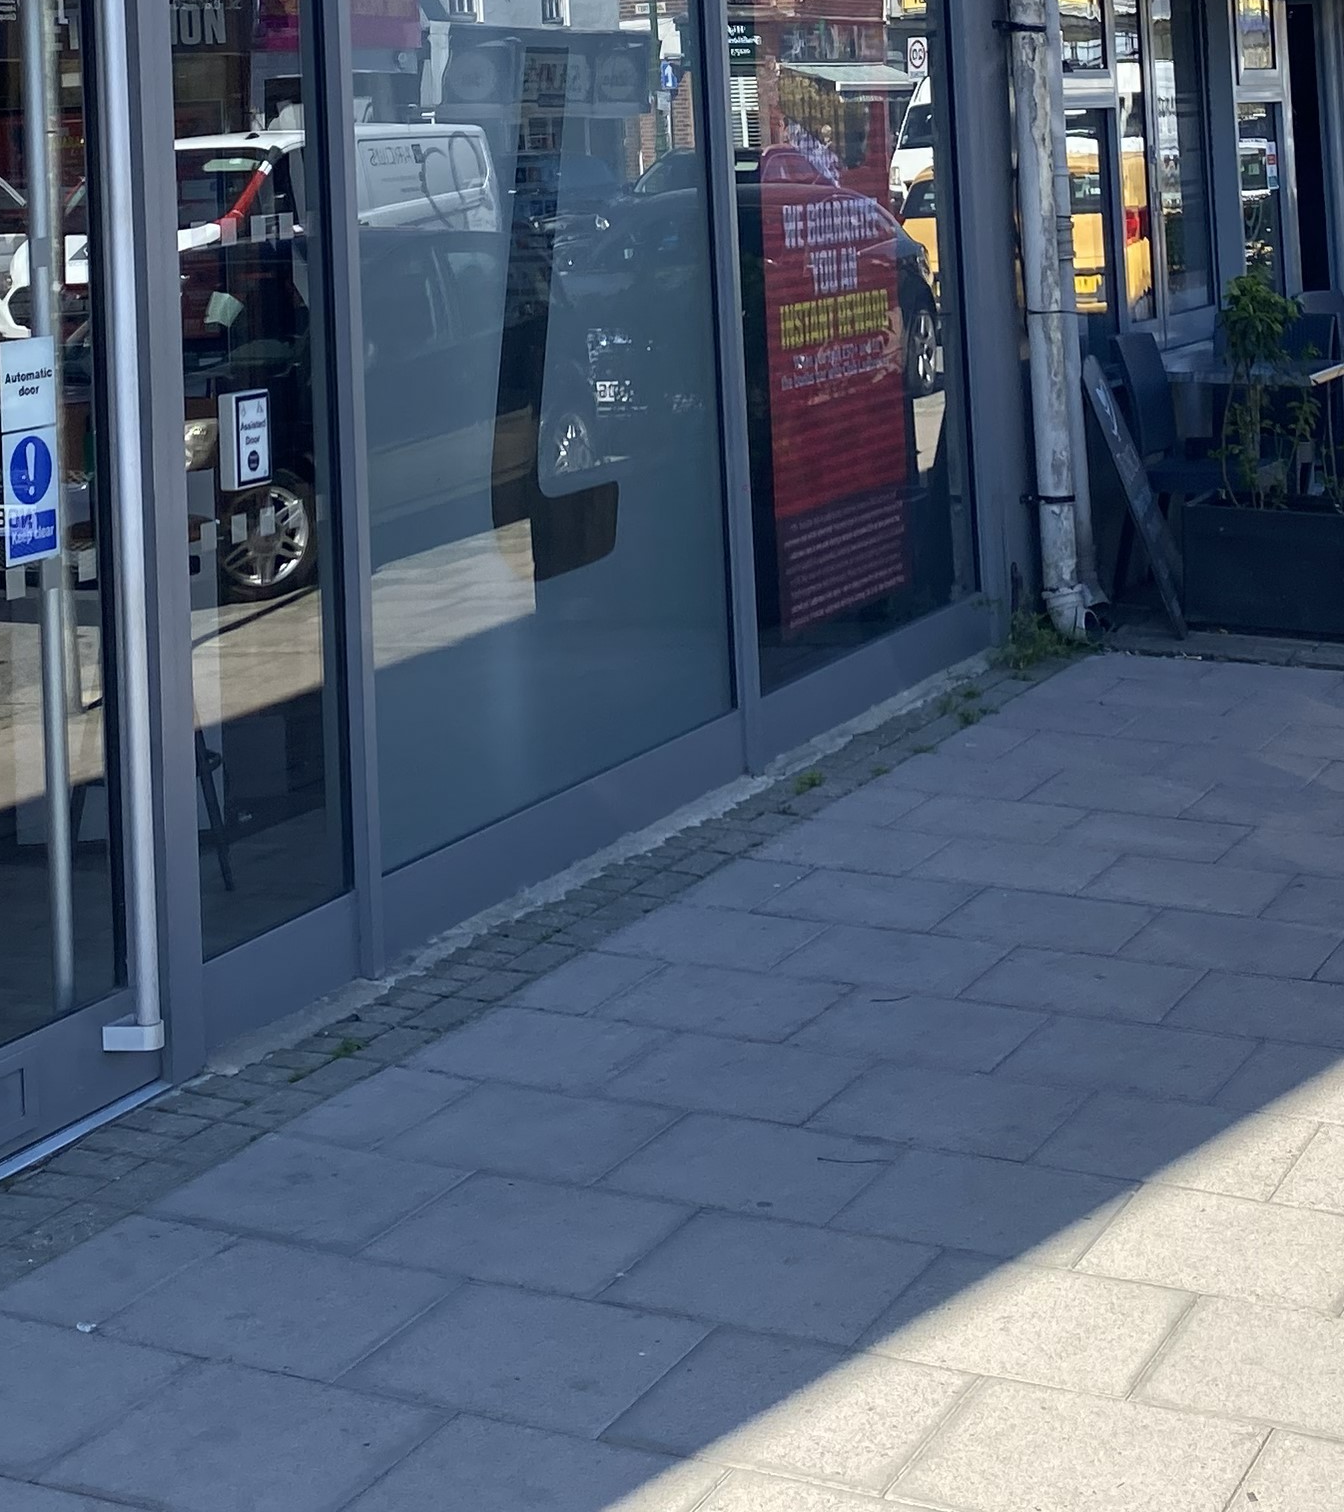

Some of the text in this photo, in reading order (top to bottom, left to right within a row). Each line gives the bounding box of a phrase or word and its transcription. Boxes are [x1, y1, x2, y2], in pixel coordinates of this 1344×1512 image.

[5, 367, 53, 384] Automatic
[19, 384, 40, 397] door
[245, 435, 261, 445] Door
[11, 524, 55, 548] Keep clear
